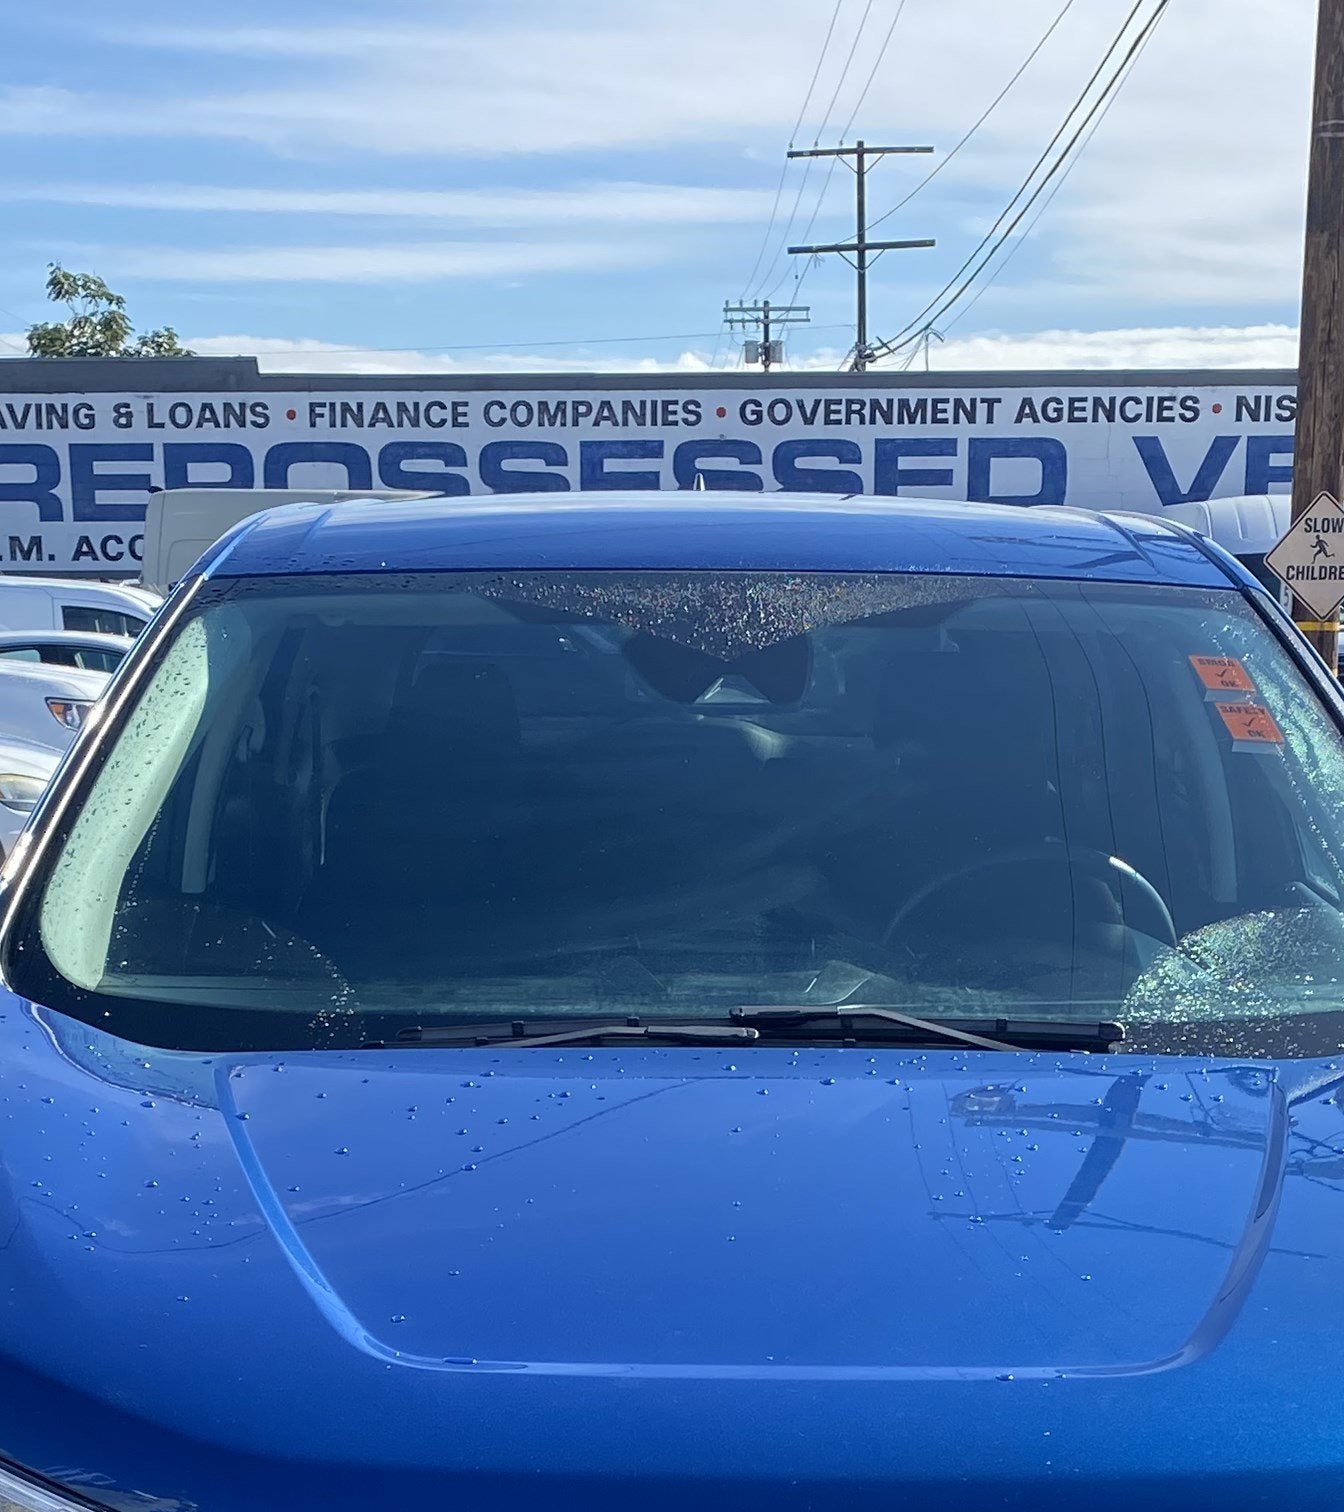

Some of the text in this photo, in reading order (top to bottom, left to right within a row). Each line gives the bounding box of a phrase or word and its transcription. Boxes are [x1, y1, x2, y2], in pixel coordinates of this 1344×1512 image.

[112, 402, 134, 430] &
[147, 401, 271, 429] LOANS
[309, 399, 702, 429] FINANCE COMPANIES
[739, 394, 1200, 427] GOVERNMENT AGENCIES
[1304, 517, 1344, 534] SLOW
